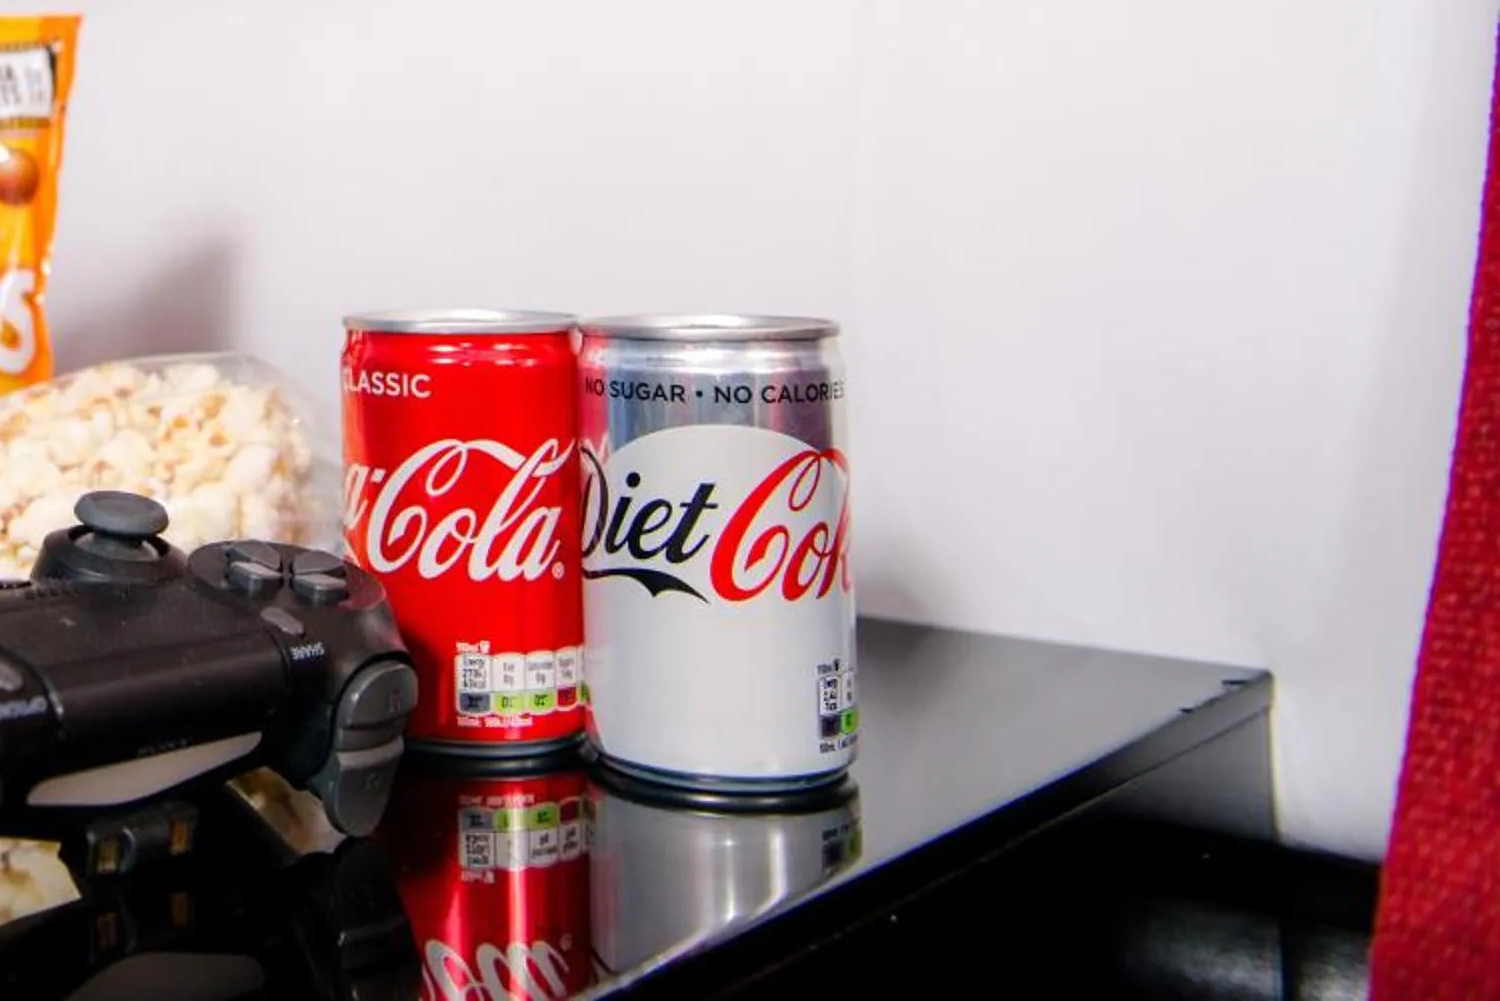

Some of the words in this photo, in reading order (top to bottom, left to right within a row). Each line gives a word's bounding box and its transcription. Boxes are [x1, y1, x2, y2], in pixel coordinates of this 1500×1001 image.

[585, 377, 605, 396] NO
[609, 380, 686, 404] SUGAR
[714, 385, 753, 404] NO
[761, 380, 844, 404] CALORIE
[709, 448, 852, 602] Cok
